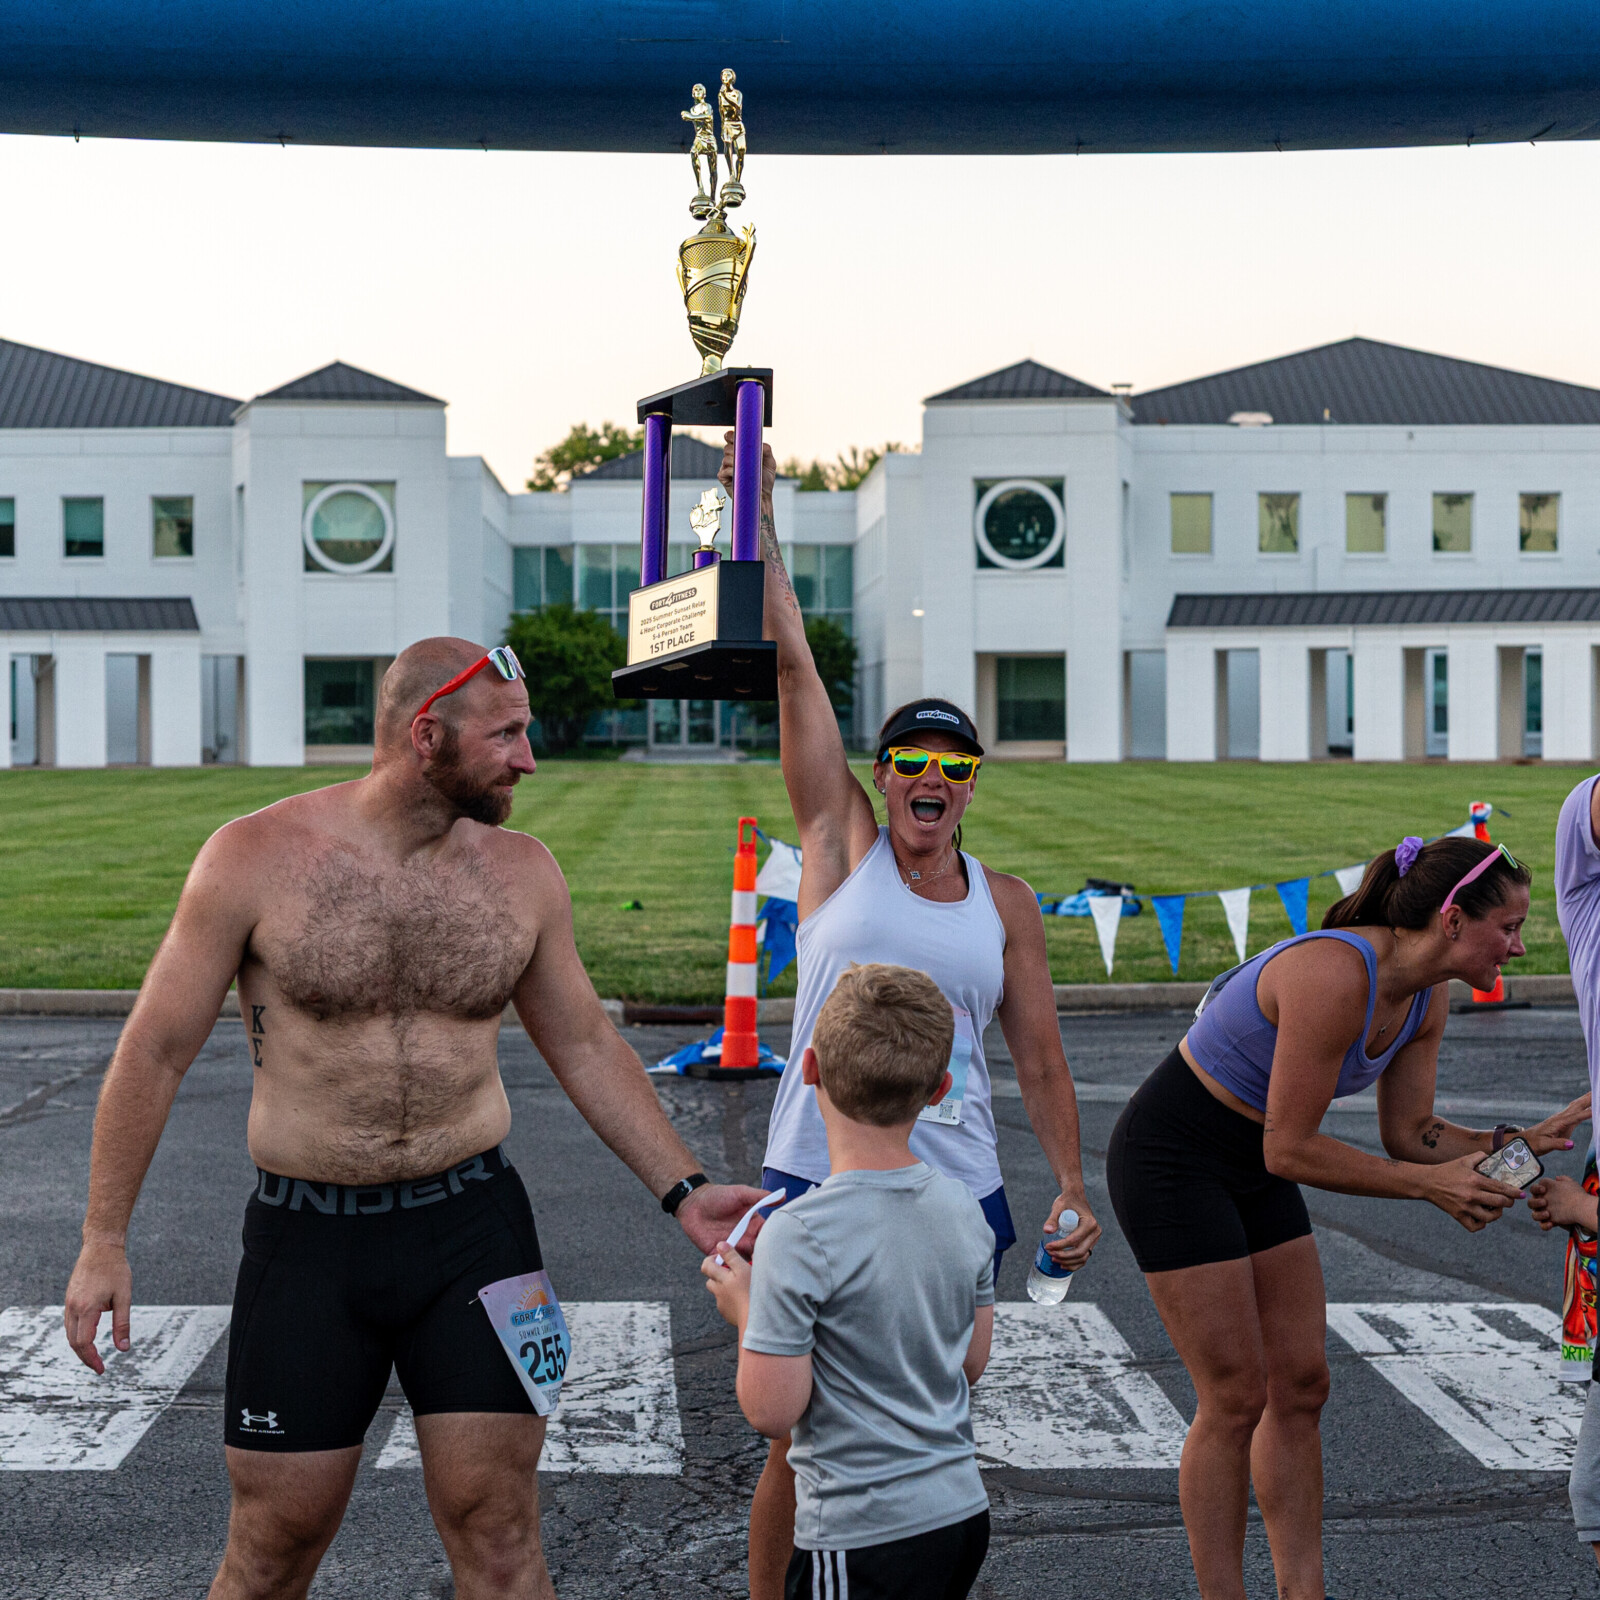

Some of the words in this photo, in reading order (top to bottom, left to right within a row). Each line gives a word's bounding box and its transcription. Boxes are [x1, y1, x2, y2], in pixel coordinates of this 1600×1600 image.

[640, 618, 652, 626] 2025
[653, 610, 673, 622] Summer
[674, 605, 691, 615] Sunset
[692, 600, 706, 609] Relay
[644, 626, 656, 634] Hour
[656, 618, 681, 630] Corporate
[682, 609, 706, 621] Challenge
[650, 641, 665, 654] 1ST
[667, 631, 695, 649] PLACE
[662, 628, 679, 637] Person
[679, 623, 693, 631] Team
[519, 1333, 567, 1385] 255
